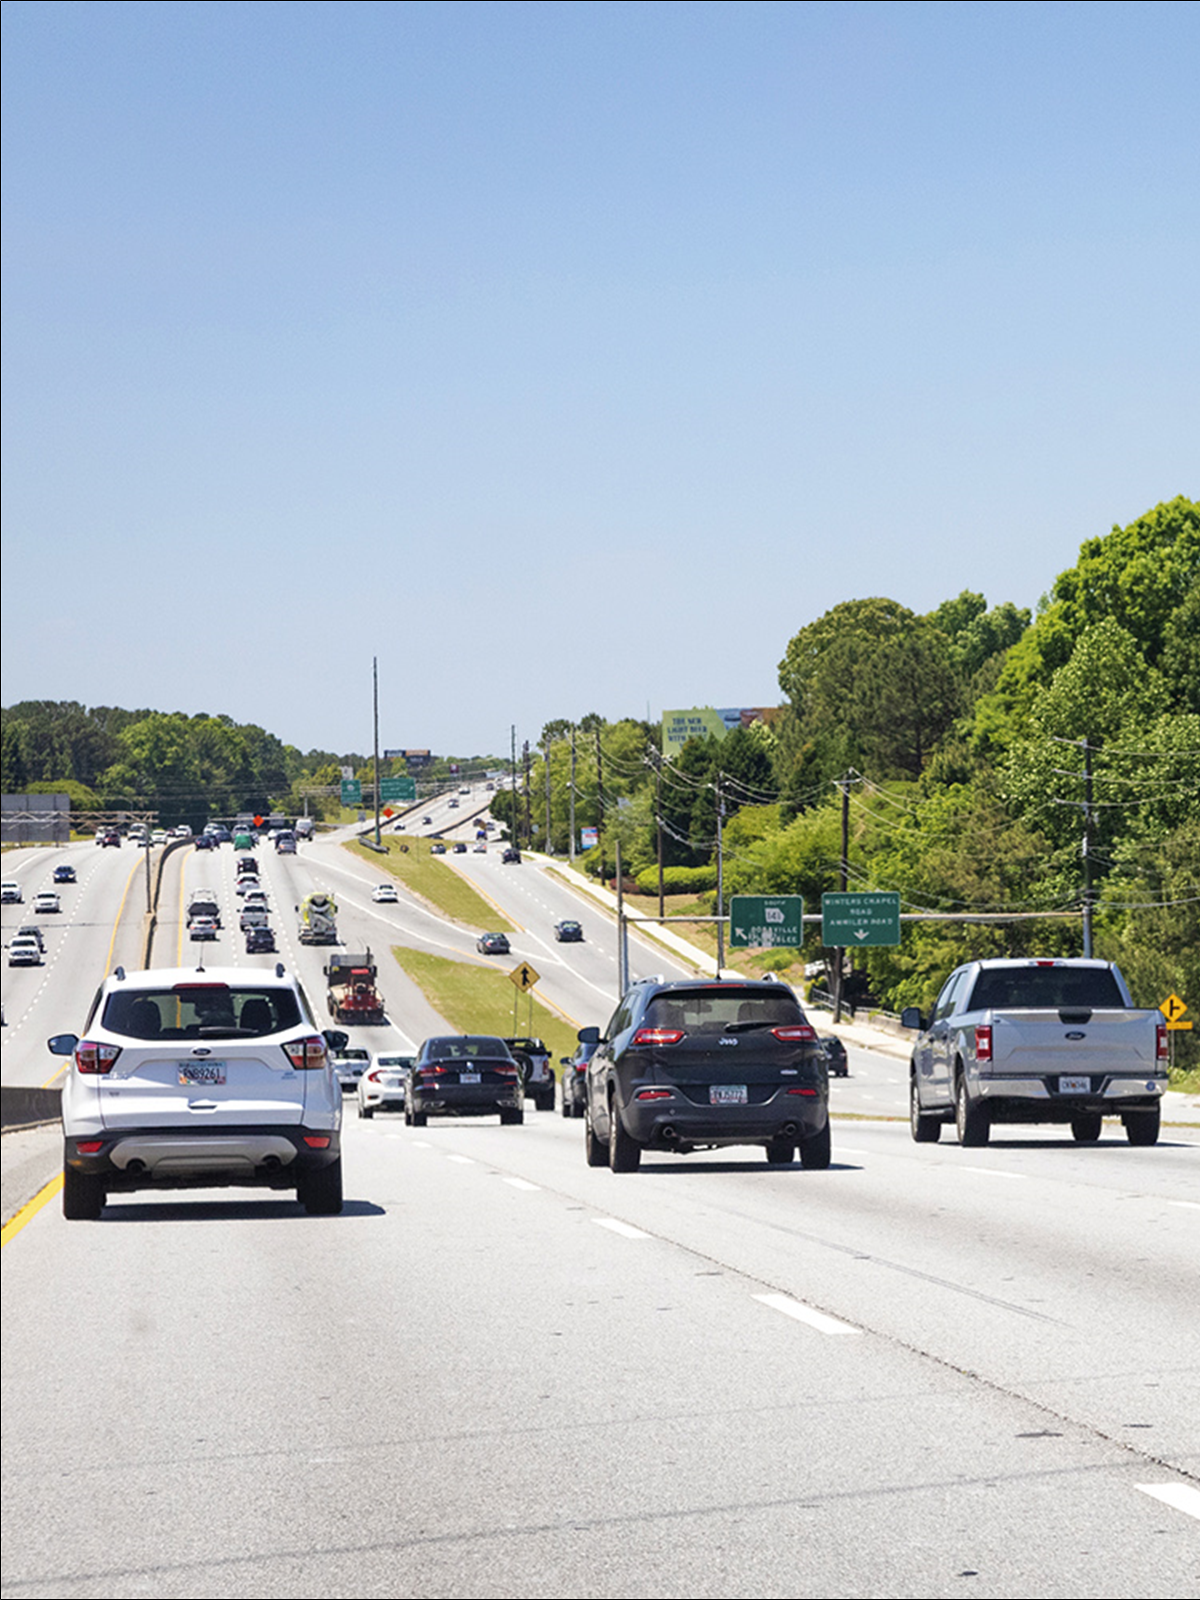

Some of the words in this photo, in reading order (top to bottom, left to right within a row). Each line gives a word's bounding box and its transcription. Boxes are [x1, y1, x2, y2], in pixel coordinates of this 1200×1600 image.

[667, 725, 688, 734] LIGHT
[690, 725, 707, 733] BEER
[863, 897, 897, 905] CHAPEL
[766, 911, 783, 920] 141
[849, 908, 873, 916] ROAD
